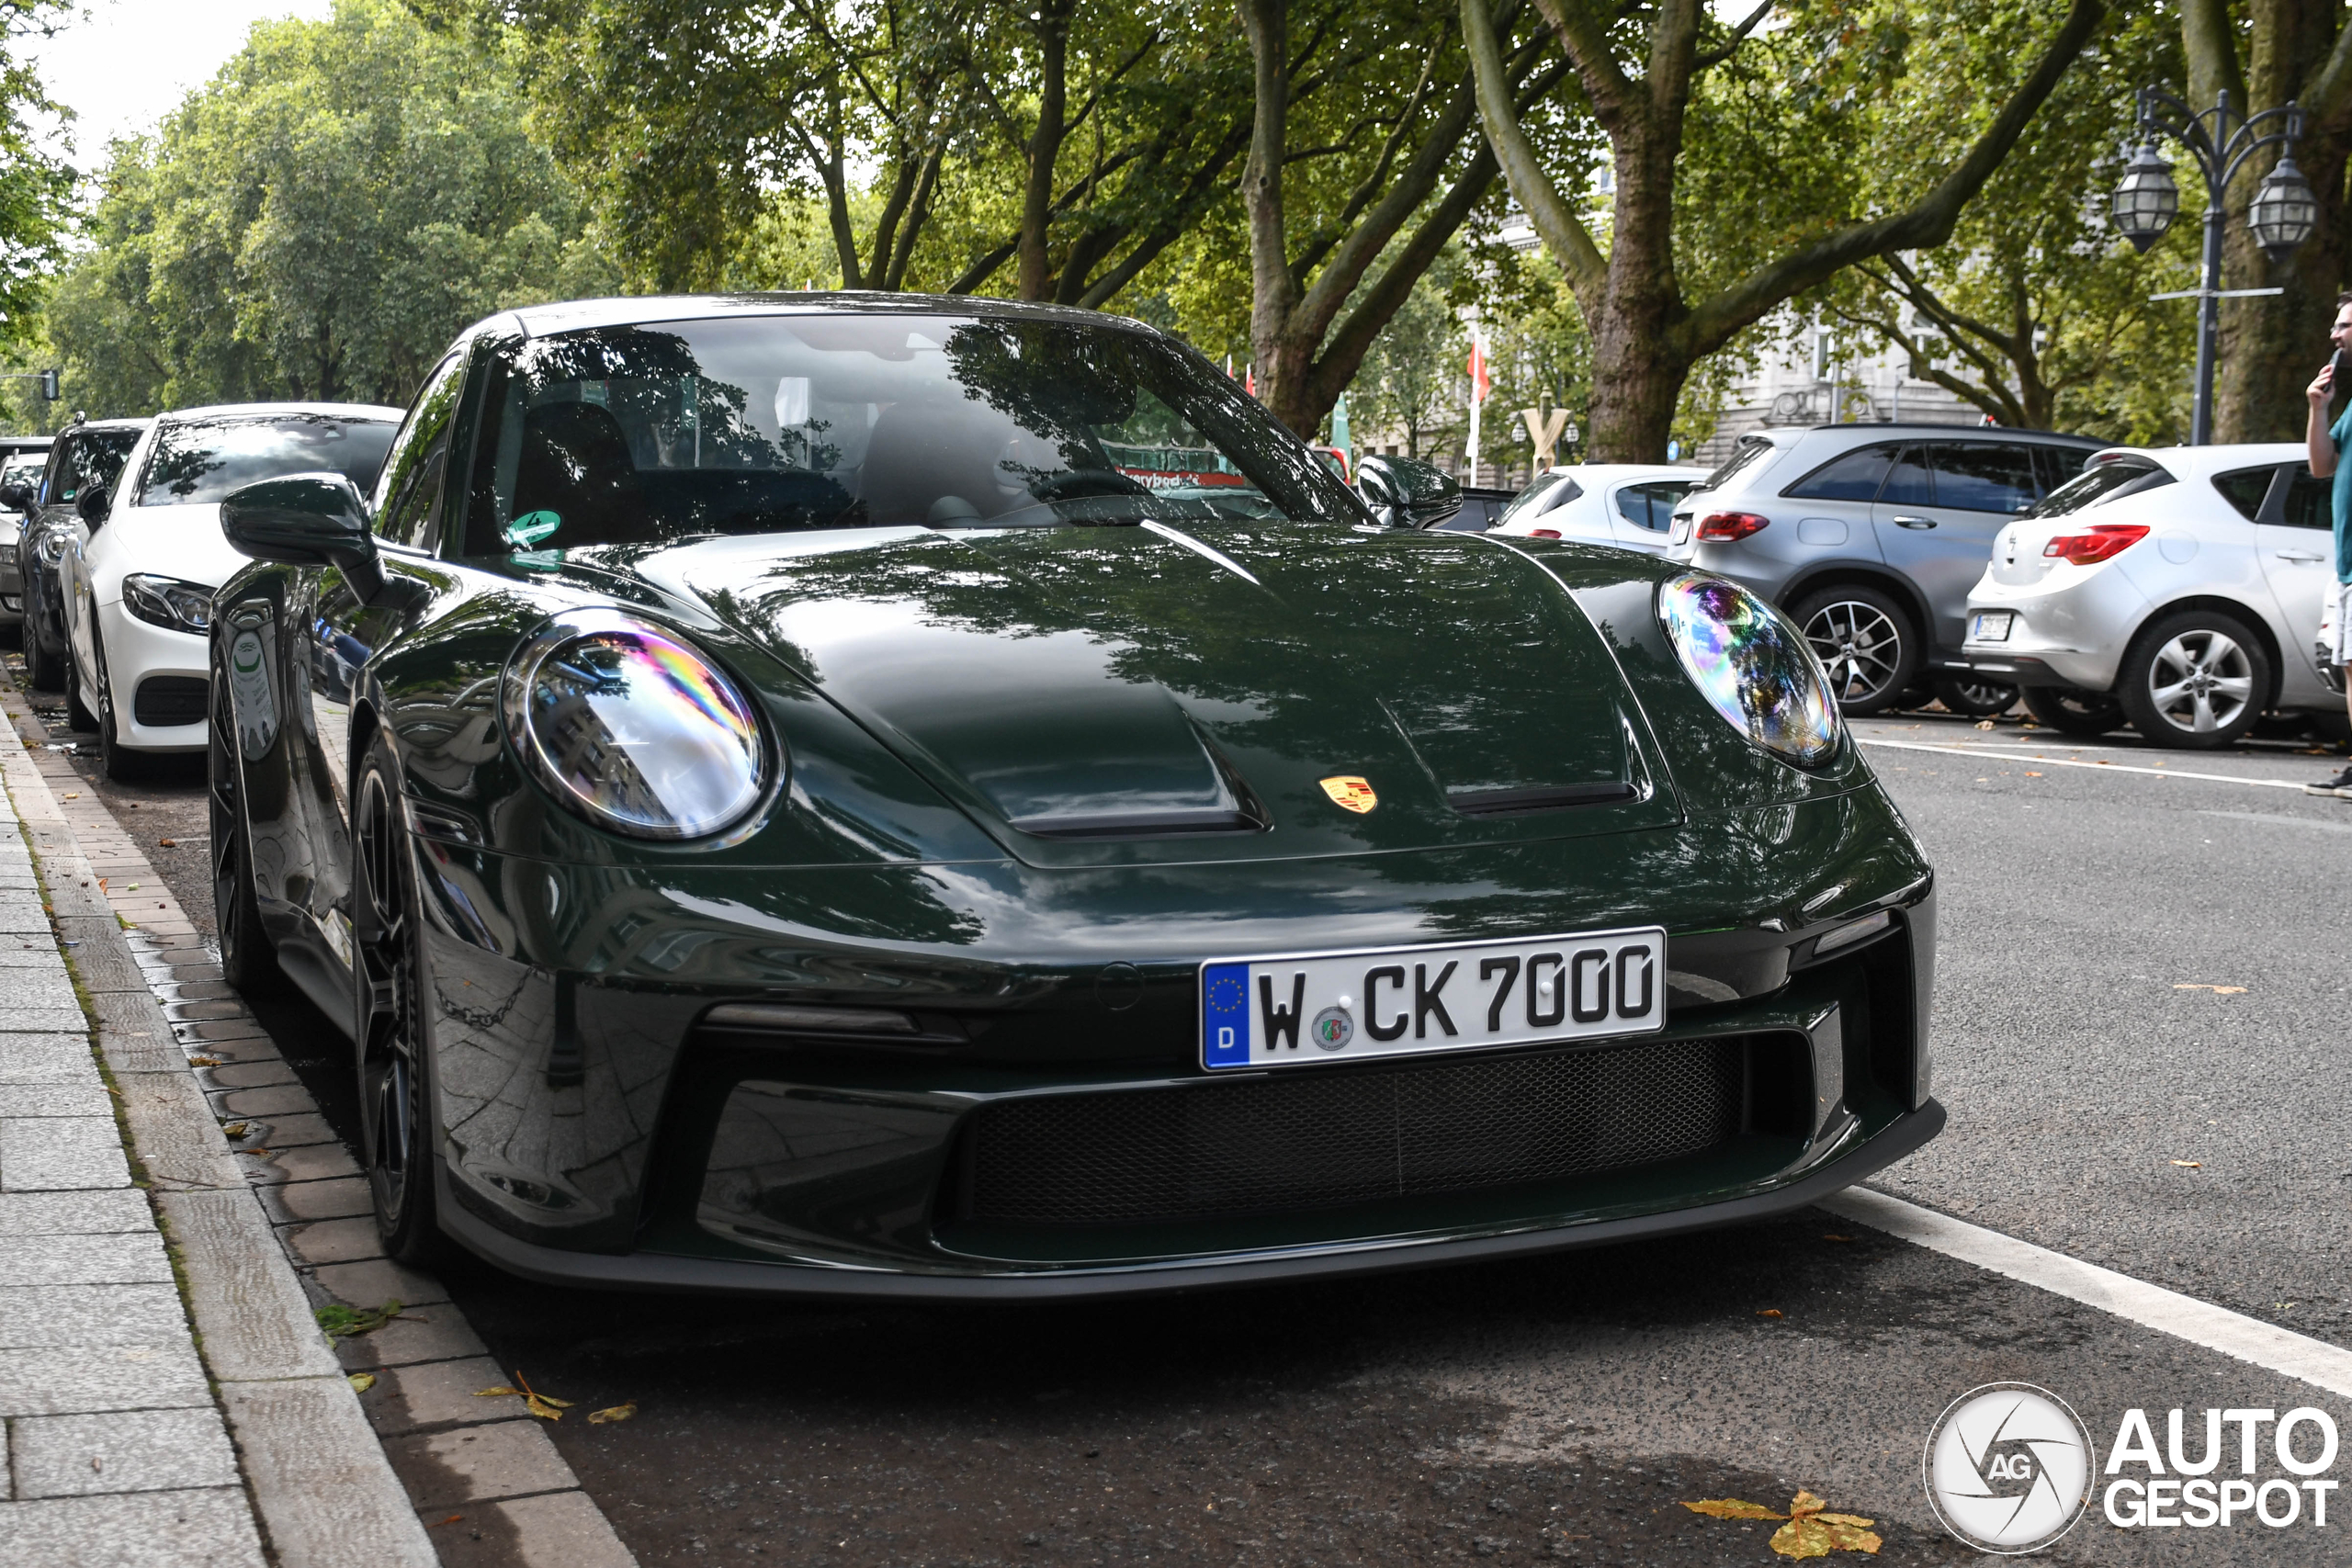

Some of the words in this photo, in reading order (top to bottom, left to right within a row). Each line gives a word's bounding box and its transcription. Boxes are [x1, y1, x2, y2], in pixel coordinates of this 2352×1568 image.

[526, 513, 542, 526] 4
[1258, 973, 1306, 1051] W
[1363, 961, 1459, 1042] CK
[1480, 944, 1654, 1032] 7000
[1218, 1026, 1235, 1049] D
